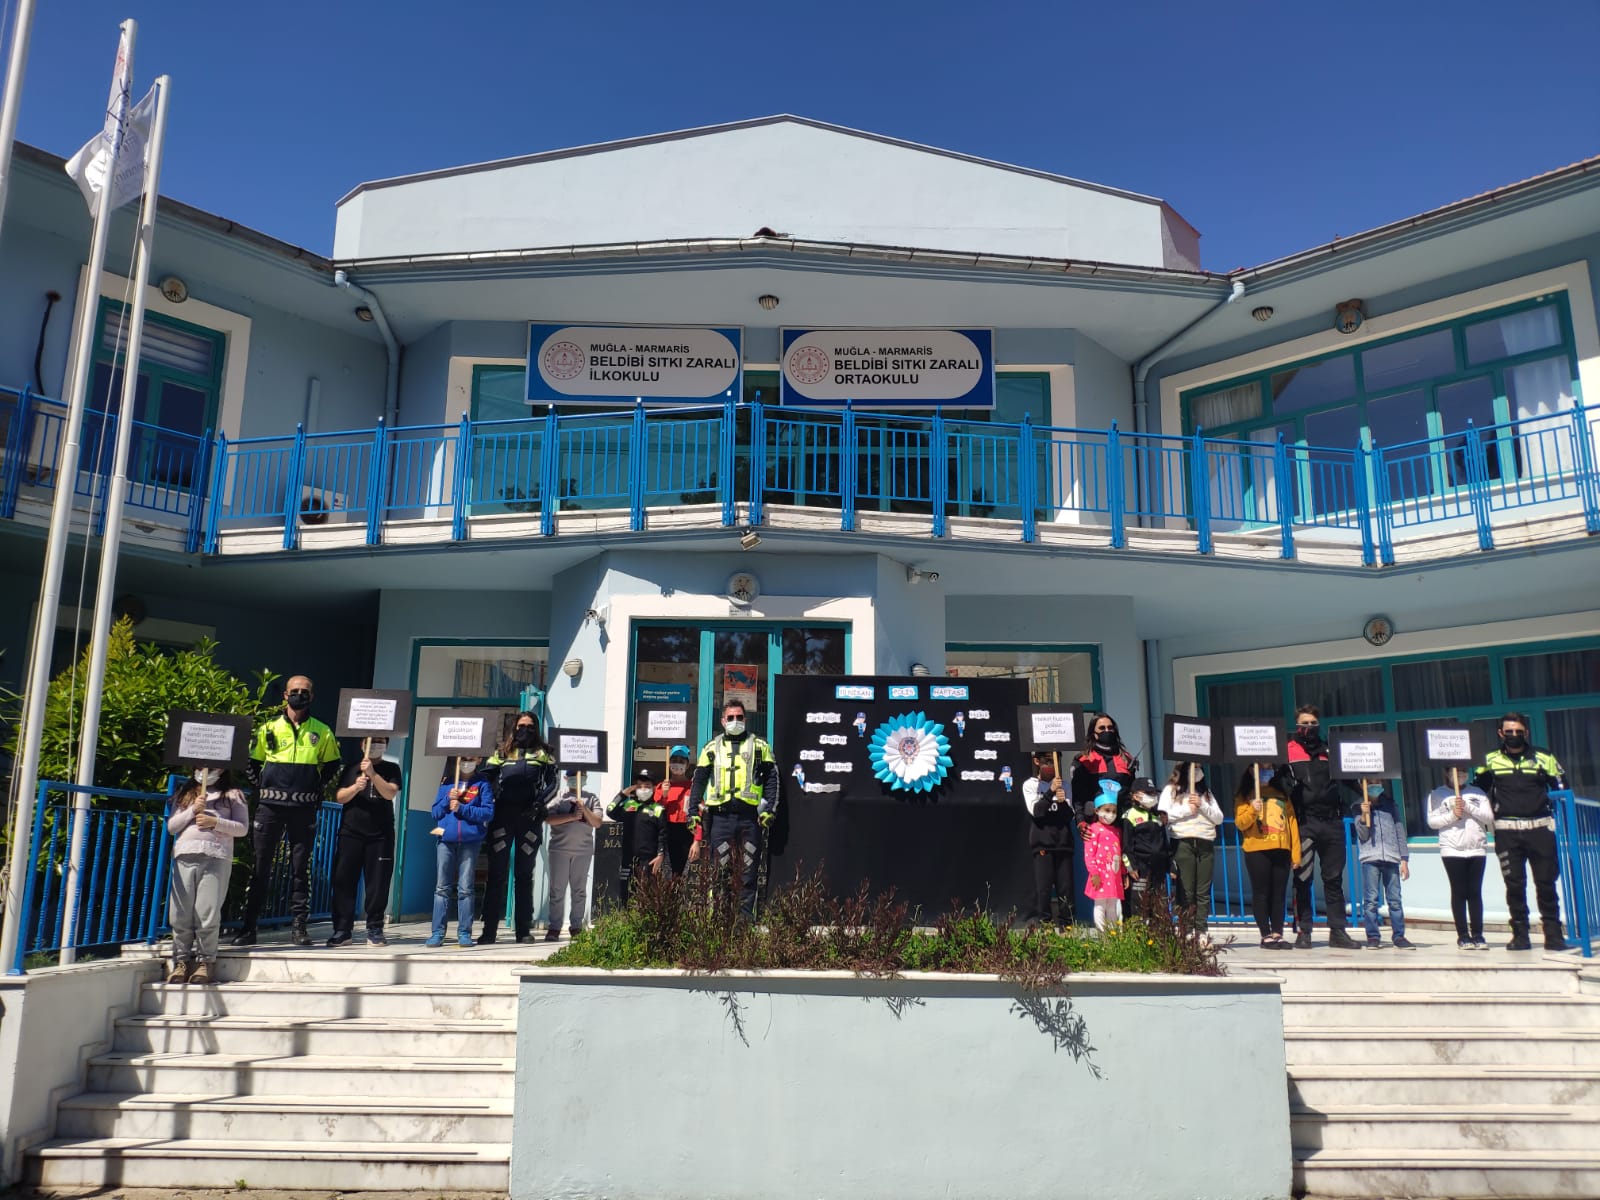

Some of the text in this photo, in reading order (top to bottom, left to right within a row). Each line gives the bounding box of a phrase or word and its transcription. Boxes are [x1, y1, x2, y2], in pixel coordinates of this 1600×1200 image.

[591, 343, 626, 352] MUĞLA
[636, 345, 689, 353] MARMARİS
[835, 347, 870, 355] MUĞLA
[879, 346, 932, 355] MARMARİS
[590, 355, 735, 368] BELDİBİ SITKI ZARALI
[835, 357, 979, 370] BELDİBİ SITKI ZARALI
[590, 368, 659, 381] İLKOKULU
[835, 374, 918, 384] ORTAOKULU
